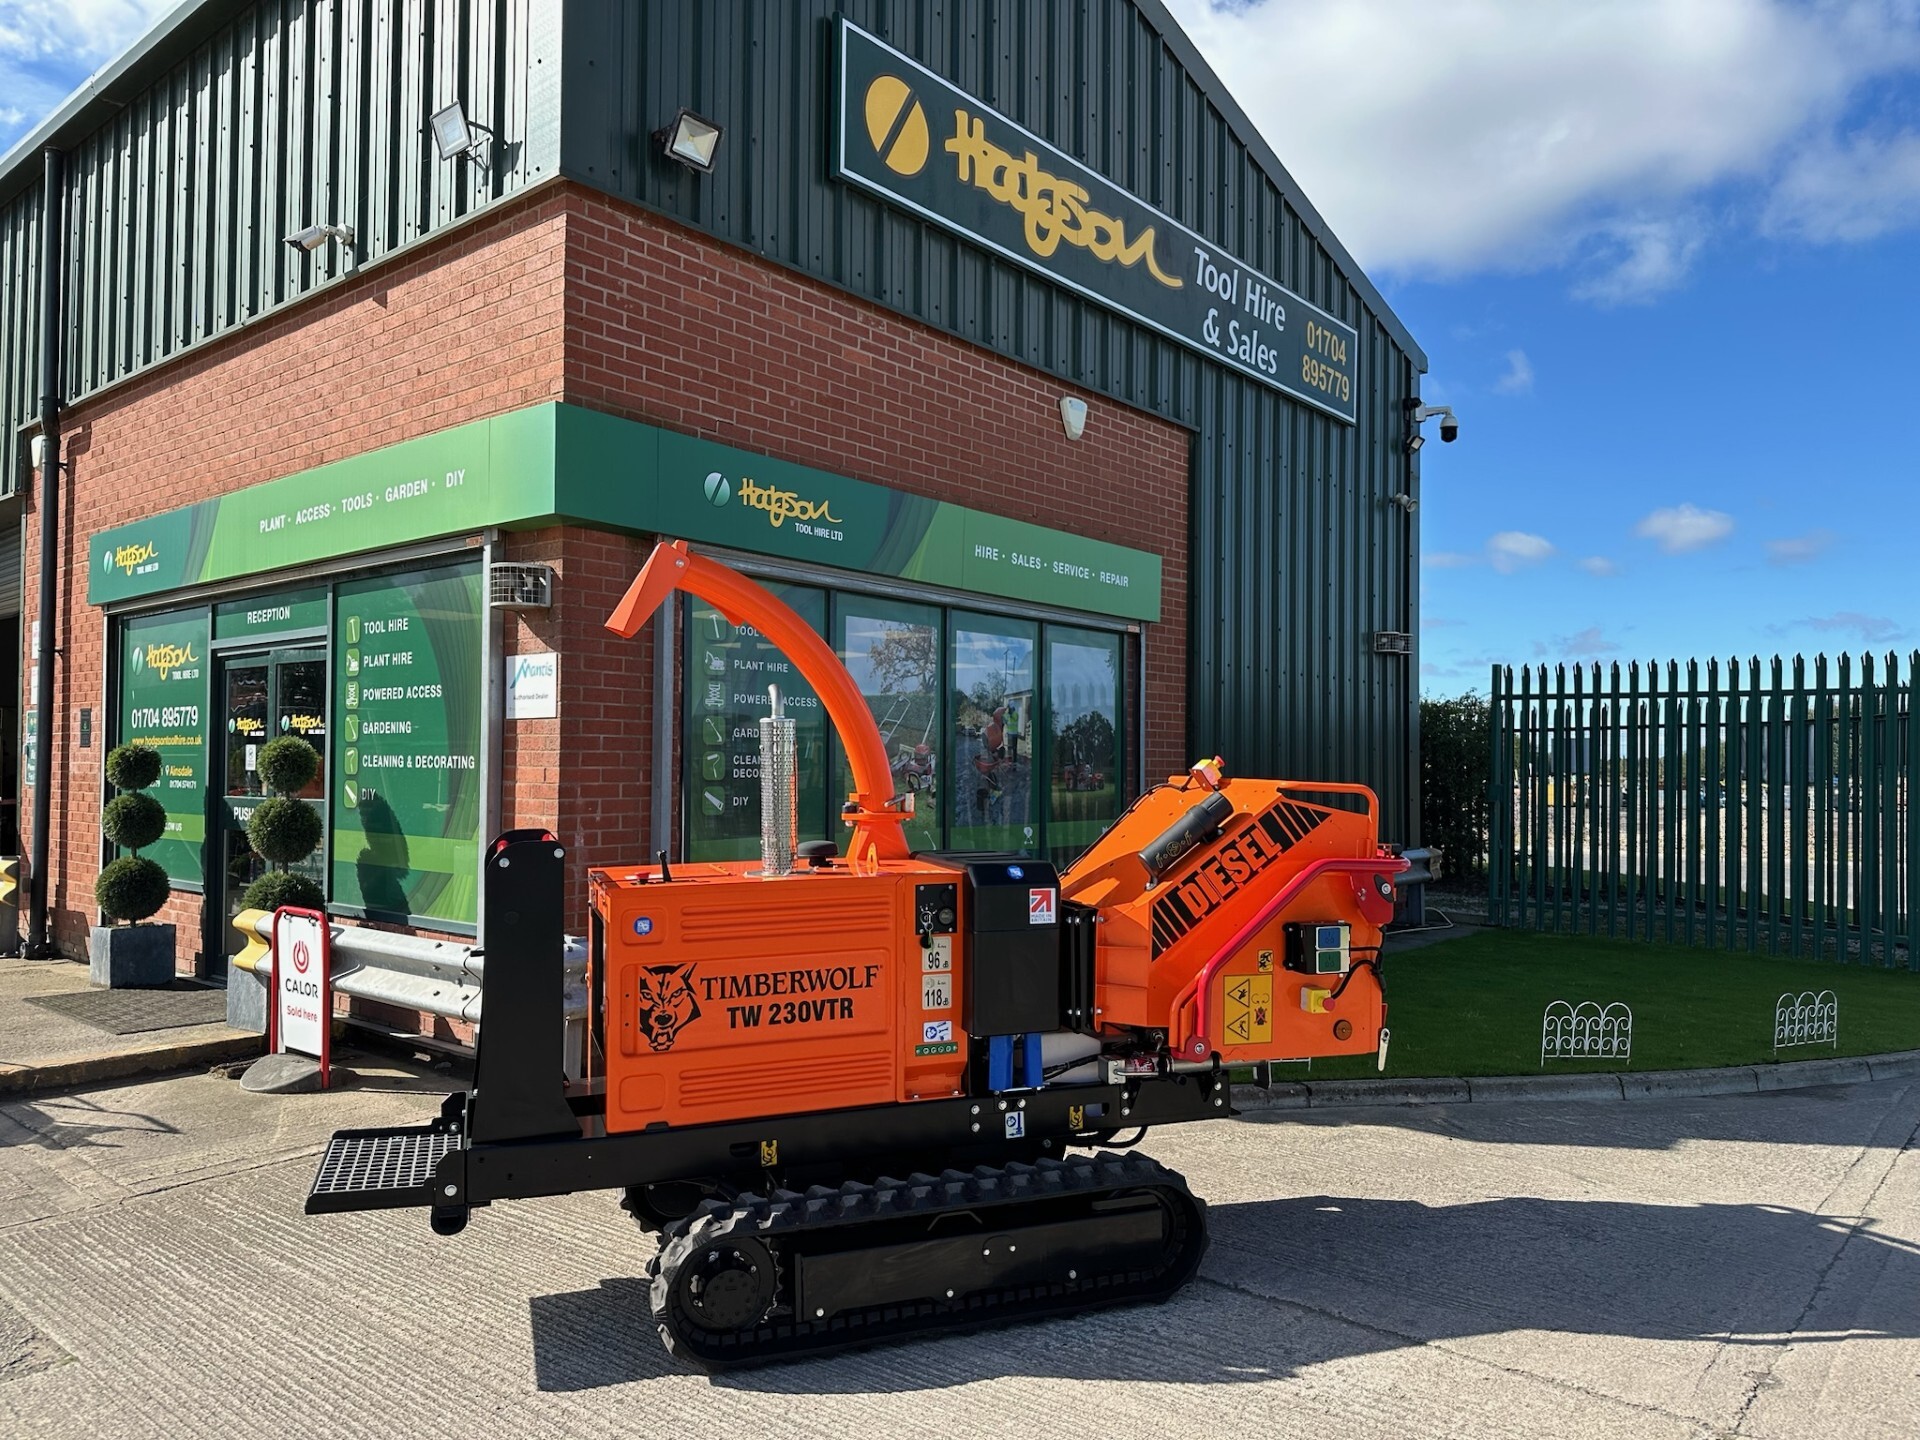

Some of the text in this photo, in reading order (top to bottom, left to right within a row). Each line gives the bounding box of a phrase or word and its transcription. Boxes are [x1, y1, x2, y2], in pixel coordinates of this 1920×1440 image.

[944, 109, 1184, 288] Hodgson
[1194, 247, 1286, 332] Tool Hire
[1203, 308, 1278, 375] & Sales
[1307, 320, 1347, 366] 01704
[1302, 354, 1350, 402] 895779
[260, 469, 466, 533] PLANT ACCESS TOOLS GARDEN DIY
[738, 477, 843, 528] Hodgson
[795, 522, 843, 541] TOOL HIRE LTD
[974, 545, 1129, 587] HIRE SALES SERVICE REPAIR
[247, 606, 291, 624] RECEPTION
[363, 617, 409, 634] TOOL HIRE
[735, 625, 759, 637] TOOL
[146, 641, 199, 680] Hodgson
[363, 651, 413, 668] PLANT HIRE
[734, 659, 788, 673] PLANT HIRE
[510, 658, 553, 689] Mantis
[363, 684, 442, 701] POWERED ACCESS
[734, 693, 817, 708] POWERE ACCESS
[131, 705, 198, 728] 01704 895779
[362, 721, 412, 734] GARDENING
[169, 765, 193, 777] Ainsdale
[362, 754, 475, 769] CLEANING & DECORATING
[361, 787, 376, 800] DIY
[733, 796, 749, 806] DIY
[1177, 826, 1283, 920] DIESEL
[928, 951, 949, 969] 96 dB
[285, 977, 319, 999] CALOR
[700, 964, 880, 1001] TIMBERWOLF
[925, 988, 943, 1007] 118
[286, 1005, 318, 1023] Sold here
[727, 997, 854, 1029] TW 230VTR
